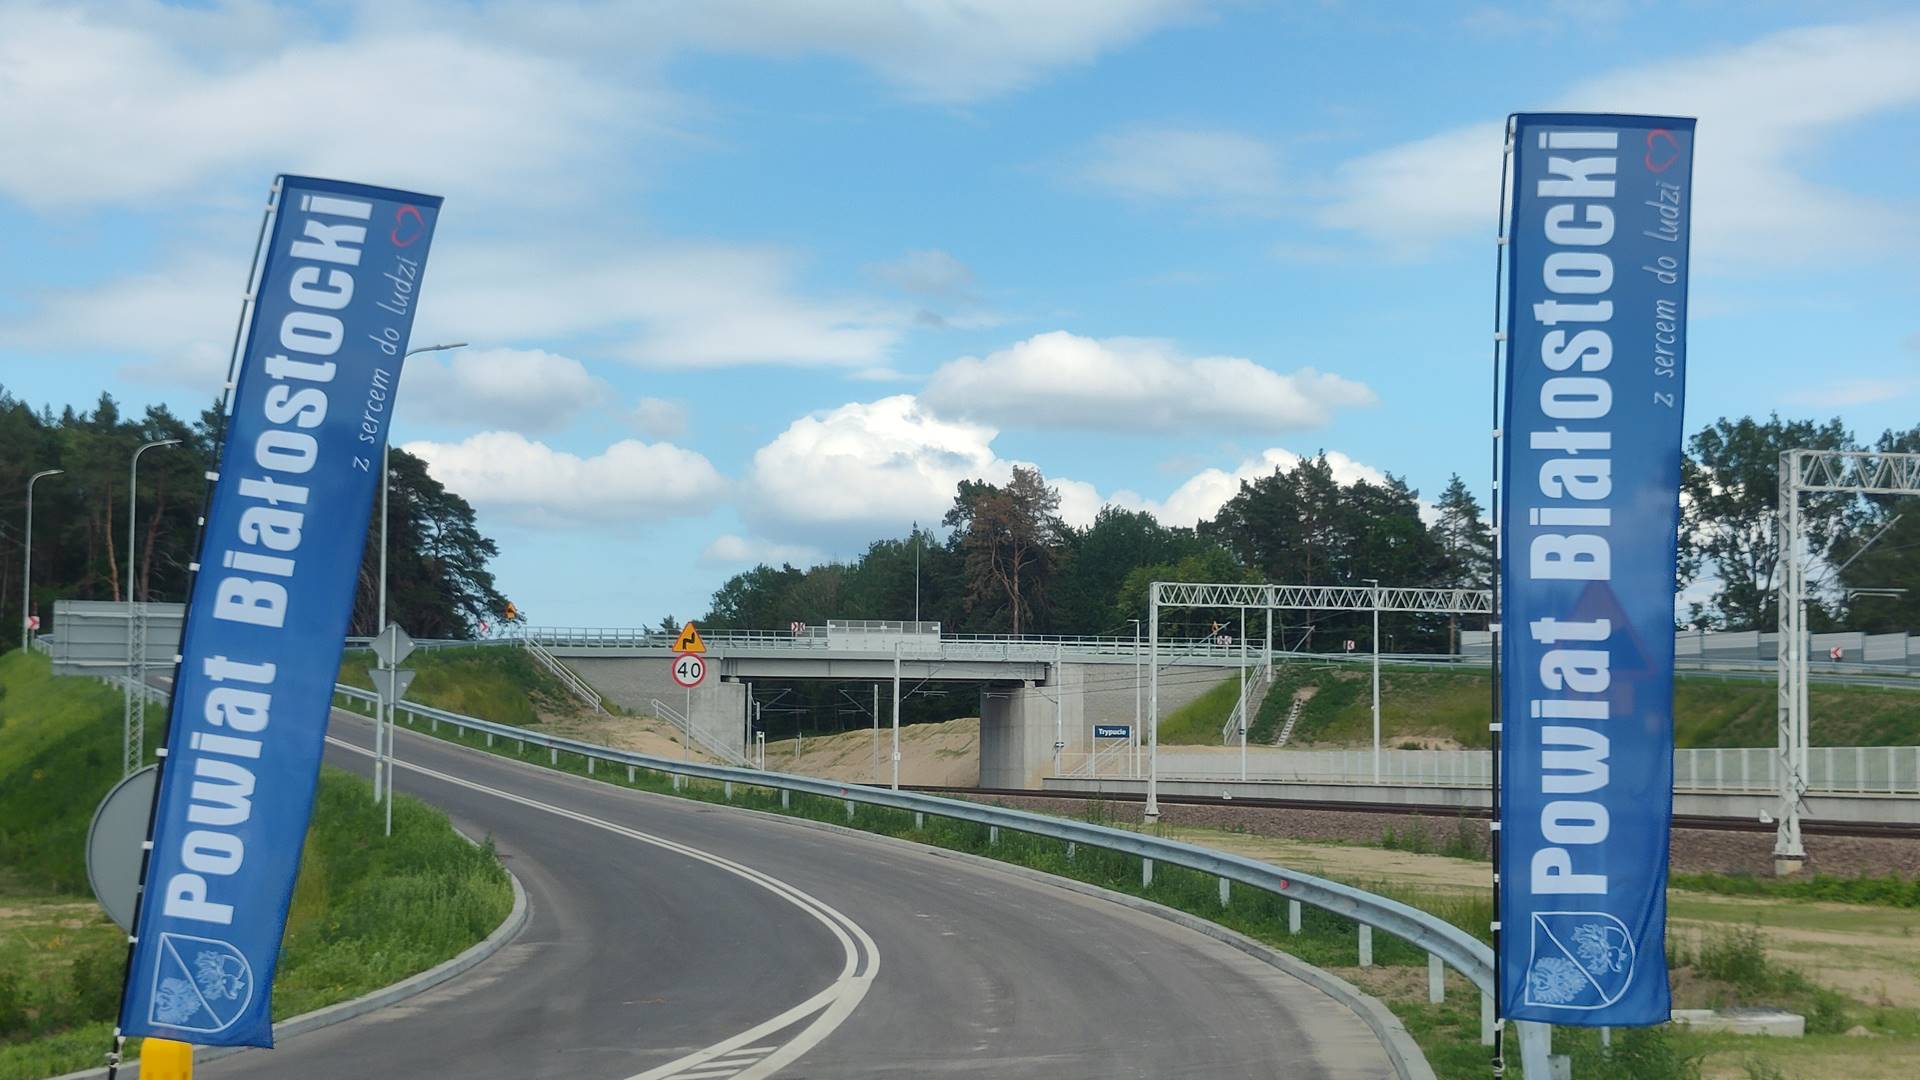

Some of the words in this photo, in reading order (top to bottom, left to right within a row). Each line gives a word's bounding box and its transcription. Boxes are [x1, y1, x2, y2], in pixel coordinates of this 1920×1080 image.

[1643, 181, 1681, 242] ludzi
[377, 255, 418, 315] ludzi
[1642, 255, 1678, 285] do
[369, 327, 400, 356] do
[1530, 131, 1618, 581] Białostocki
[1654, 299, 1677, 378] sercem
[213, 195, 373, 628] Białostocki
[360, 367, 390, 444] sercem
[1654, 393, 1674, 408] z
[353, 455, 370, 473] z
[677, 662, 701, 679] 40
[1530, 616, 1611, 895] Powiat
[163, 655, 276, 925] Powiat
